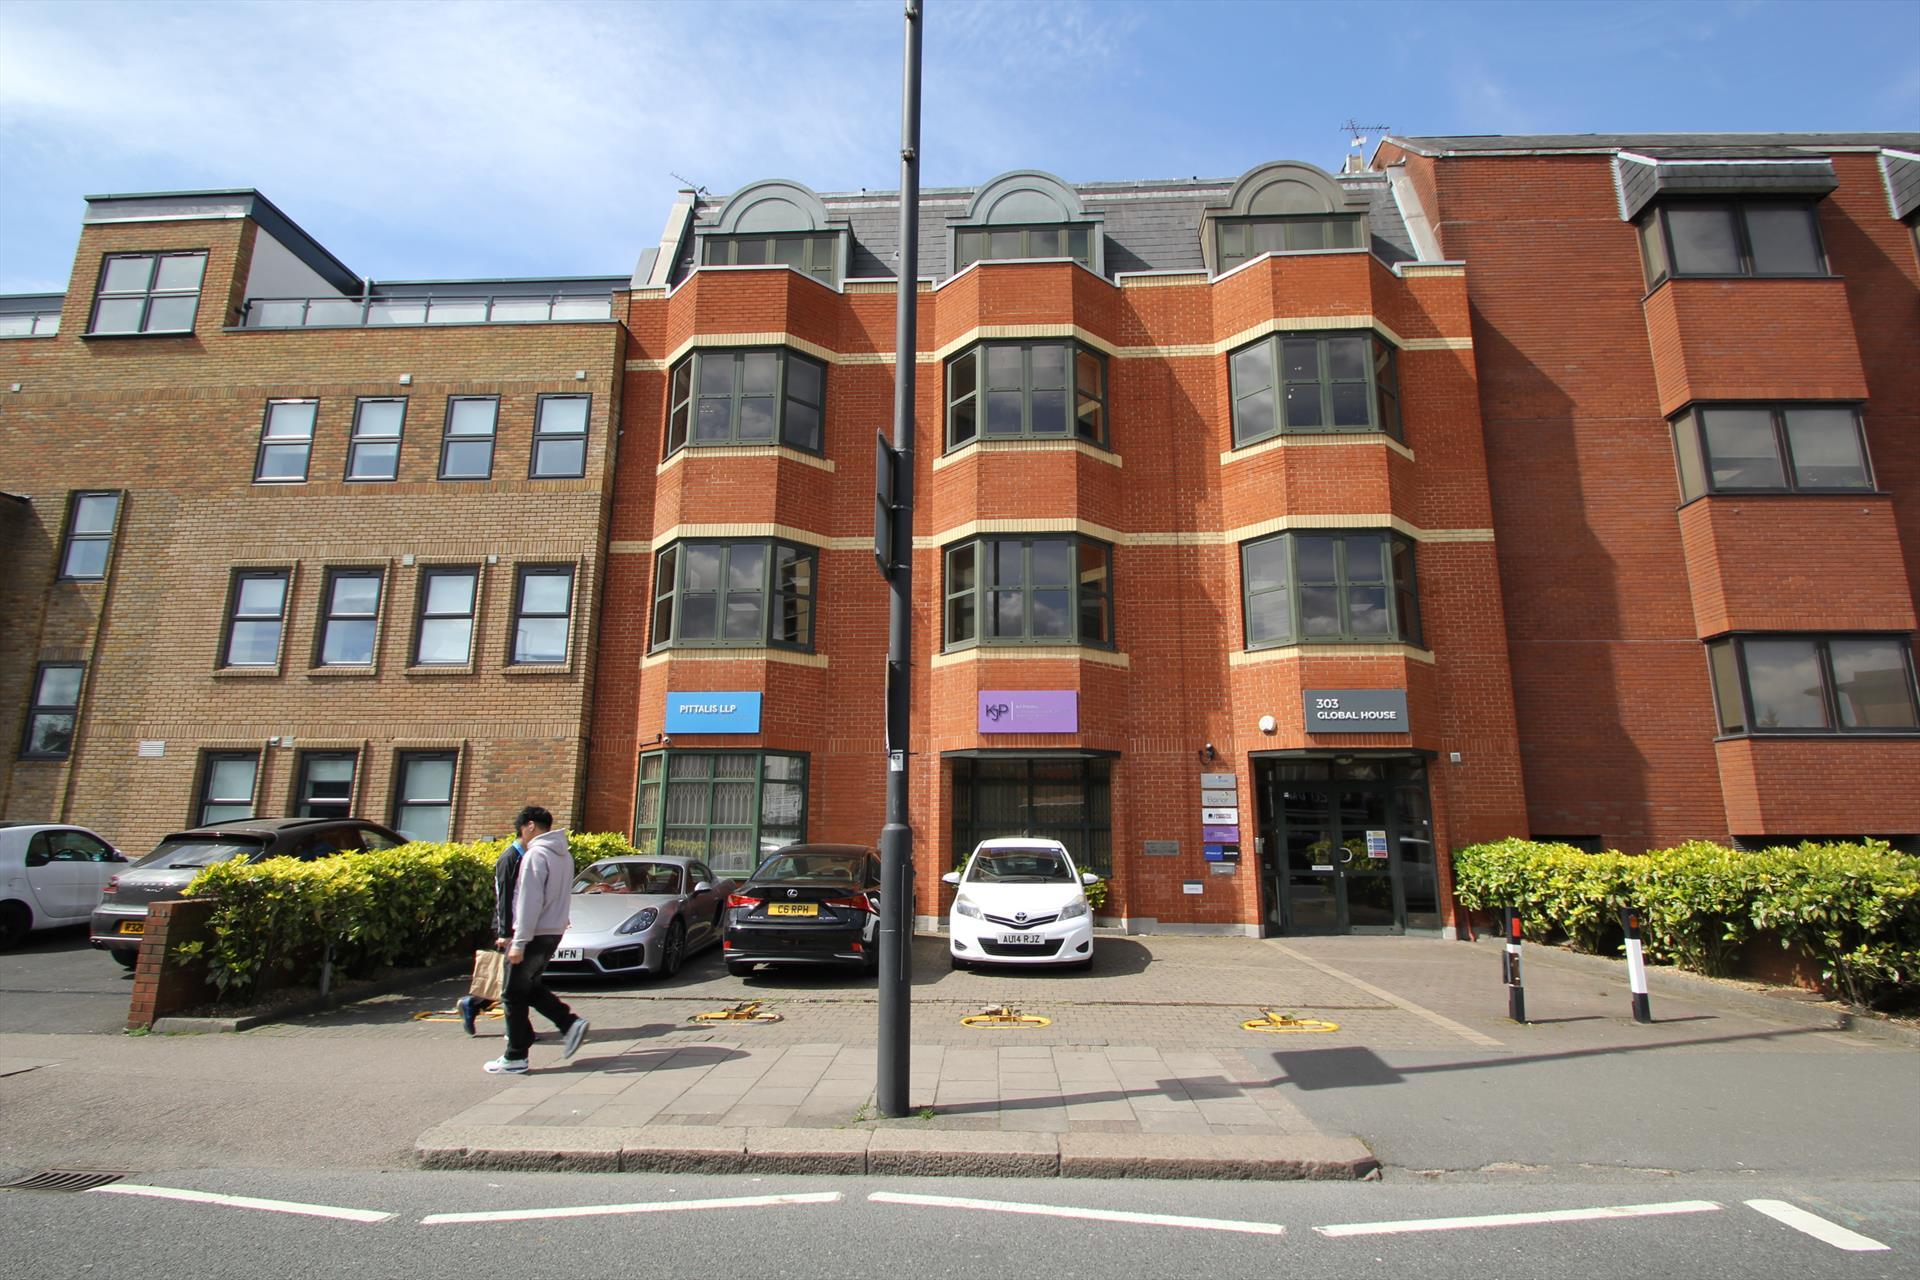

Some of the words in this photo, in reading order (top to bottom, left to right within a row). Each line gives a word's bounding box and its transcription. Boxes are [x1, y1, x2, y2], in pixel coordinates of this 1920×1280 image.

[679, 704, 718, 713] PITTALIS
[719, 704, 737, 713] LLP
[1316, 698, 1340, 709] 303
[1317, 711, 1359, 720] GLOBAL
[1360, 711, 1397, 719] HOUSE
[777, 904, 789, 914] C6
[791, 904, 809, 914] RPH
[1003, 934, 1021, 943] AU14
[1023, 934, 1040, 944] RJZ
[558, 949, 577, 959] WFN
